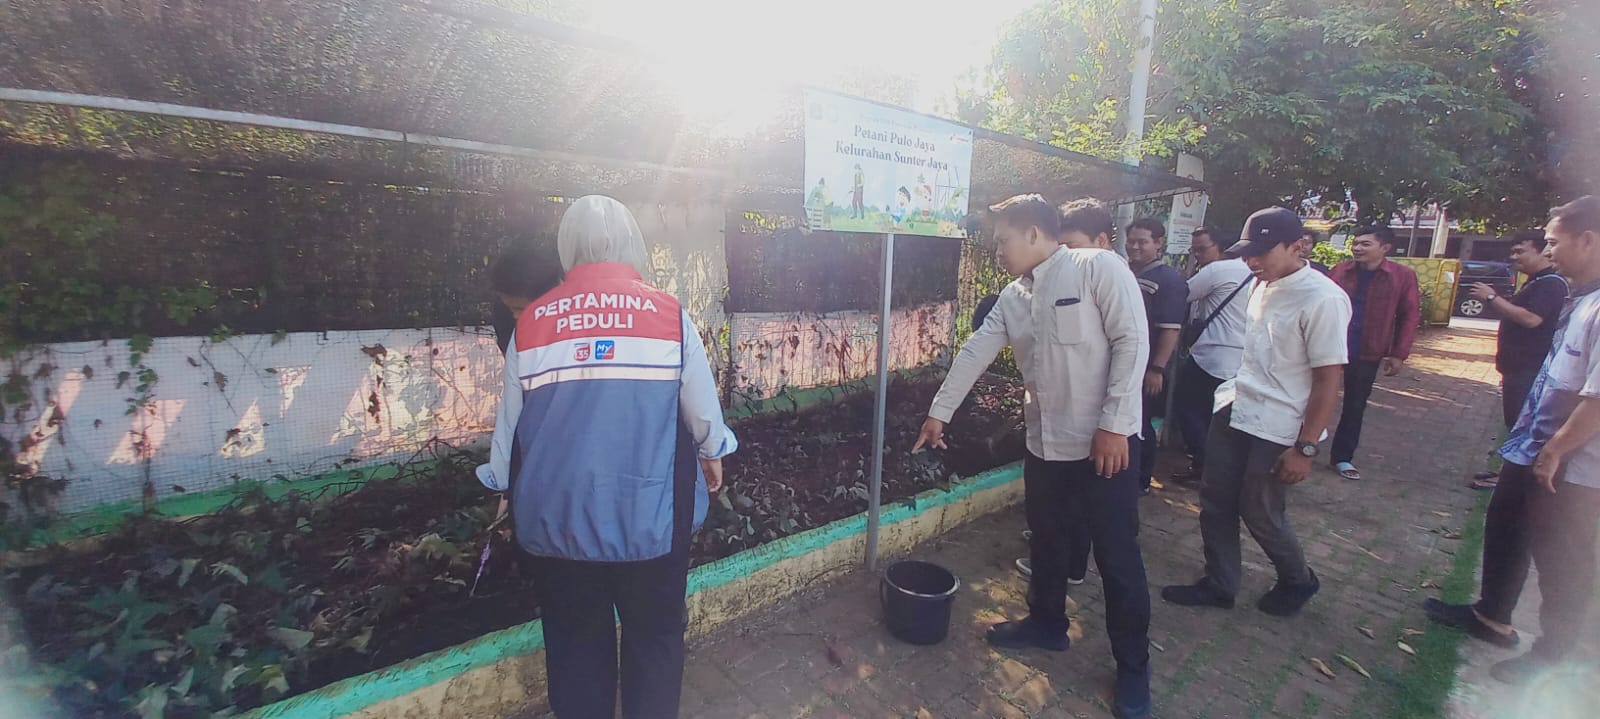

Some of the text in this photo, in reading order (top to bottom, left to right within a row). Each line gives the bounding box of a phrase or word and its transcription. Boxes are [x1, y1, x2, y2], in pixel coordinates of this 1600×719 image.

[854, 125, 936, 153] Petani Pulo Jaya
[835, 141, 948, 171] Kelurahan Sunter Jaya
[534, 292, 658, 321] PERTAMINA
[556, 313, 634, 334] PEDULI
